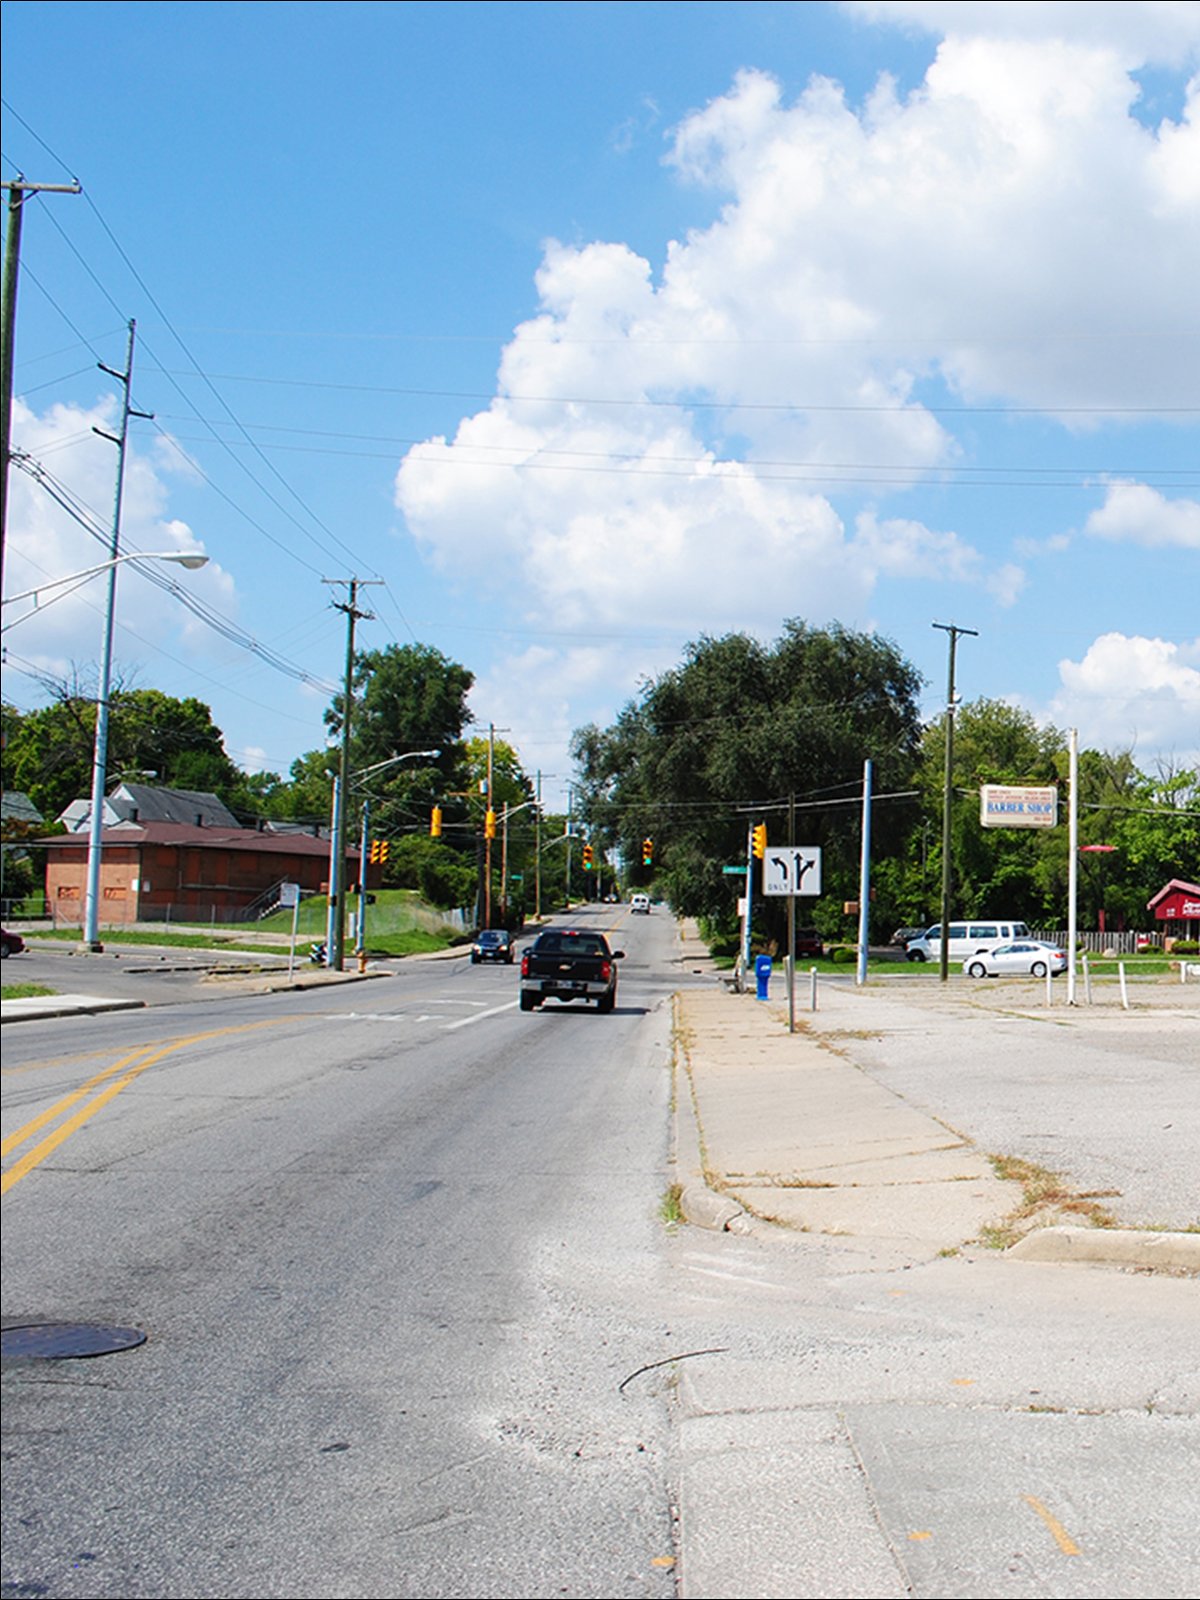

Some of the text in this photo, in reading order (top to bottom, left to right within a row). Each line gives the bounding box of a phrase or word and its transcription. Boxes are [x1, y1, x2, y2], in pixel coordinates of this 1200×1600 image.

[987, 802, 1053, 813] BARBER SHOP
[768, 883, 788, 891] ONLY
